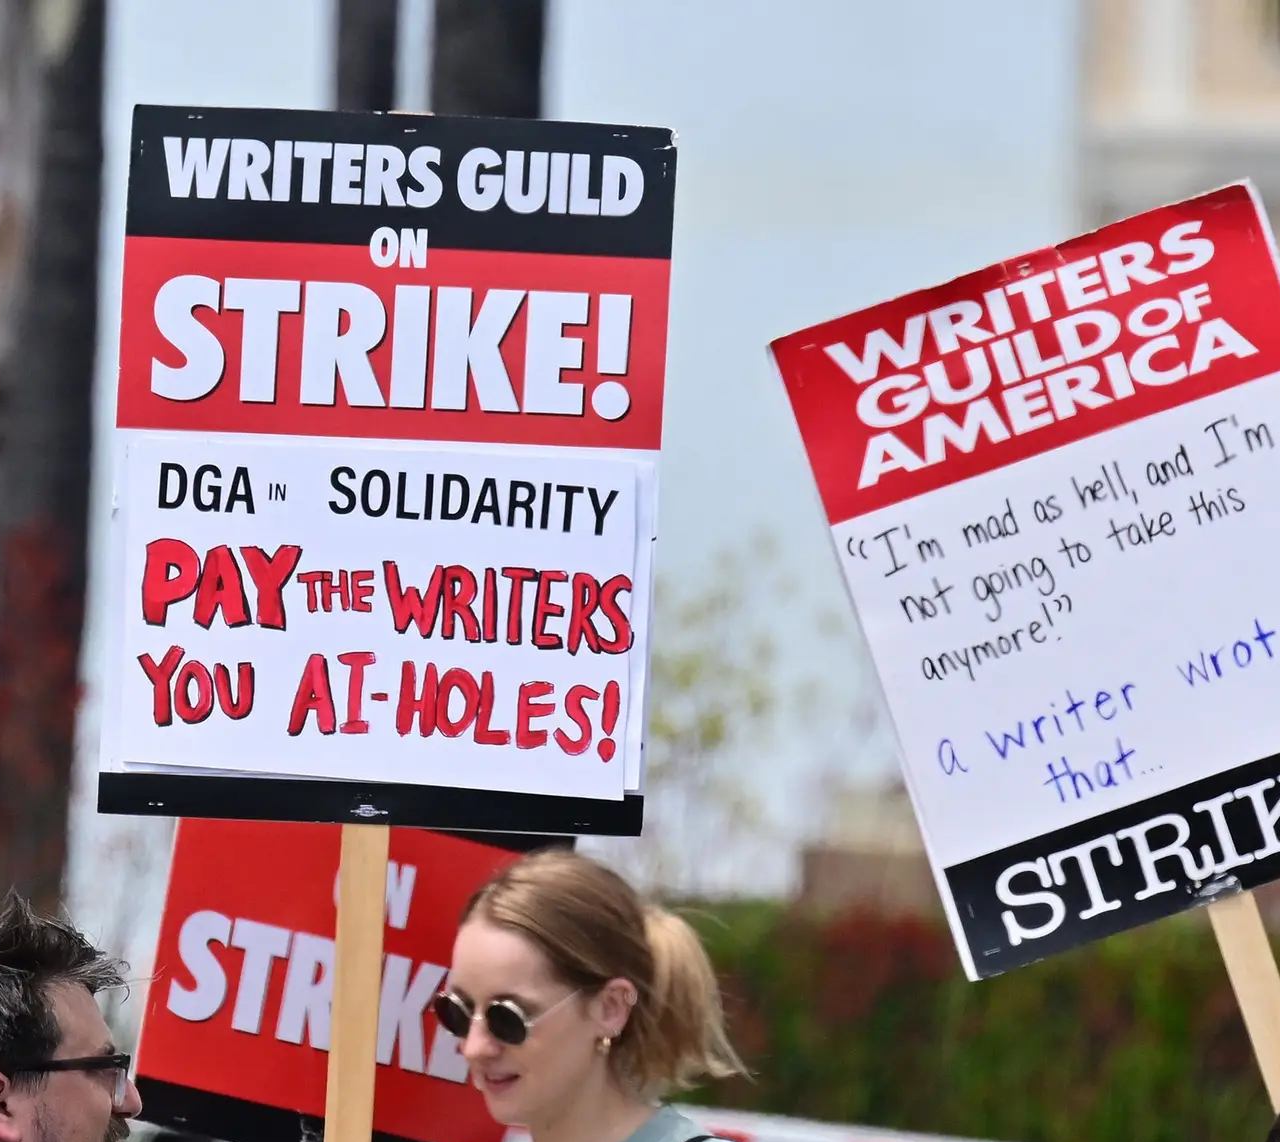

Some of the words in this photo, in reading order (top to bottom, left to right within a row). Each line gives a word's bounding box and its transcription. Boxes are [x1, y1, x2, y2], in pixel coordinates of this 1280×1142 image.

[162, 137, 443, 210] WRITERS
[456, 147, 645, 217] GUILD
[369, 226, 428, 269] ON
[823, 220, 1215, 385] WRITERS
[150, 274, 633, 422] STRIKE!
[855, 308, 1122, 428] GUILD
[1128, 283, 1213, 339] OF
[856, 317, 1260, 490] AMERICA
[157, 462, 256, 515] DGA
[268, 482, 287, 503] IN
[328, 466, 619, 537] SOLIDARITY
[900, 580, 955, 624] not
[973, 554, 1055, 621] going
[1058, 532, 1092, 567] to
[1106, 506, 1177, 556] take
[1188, 484, 1247, 526] this
[962, 502, 1019, 546] mad
[1034, 498, 1063, 523] as
[1072, 460, 1139, 506] hell,
[1145, 445, 1193, 486] and
[141, 538, 303, 630] PAY
[300, 569, 375, 613] THE
[383, 560, 634, 656] WRITERS
[137, 645, 256, 727] YOU
[287, 651, 620, 763] AI-HOLES!
[937, 738, 966, 776] a
[986, 680, 1136, 757] writer
[333, 860, 417, 929] N
